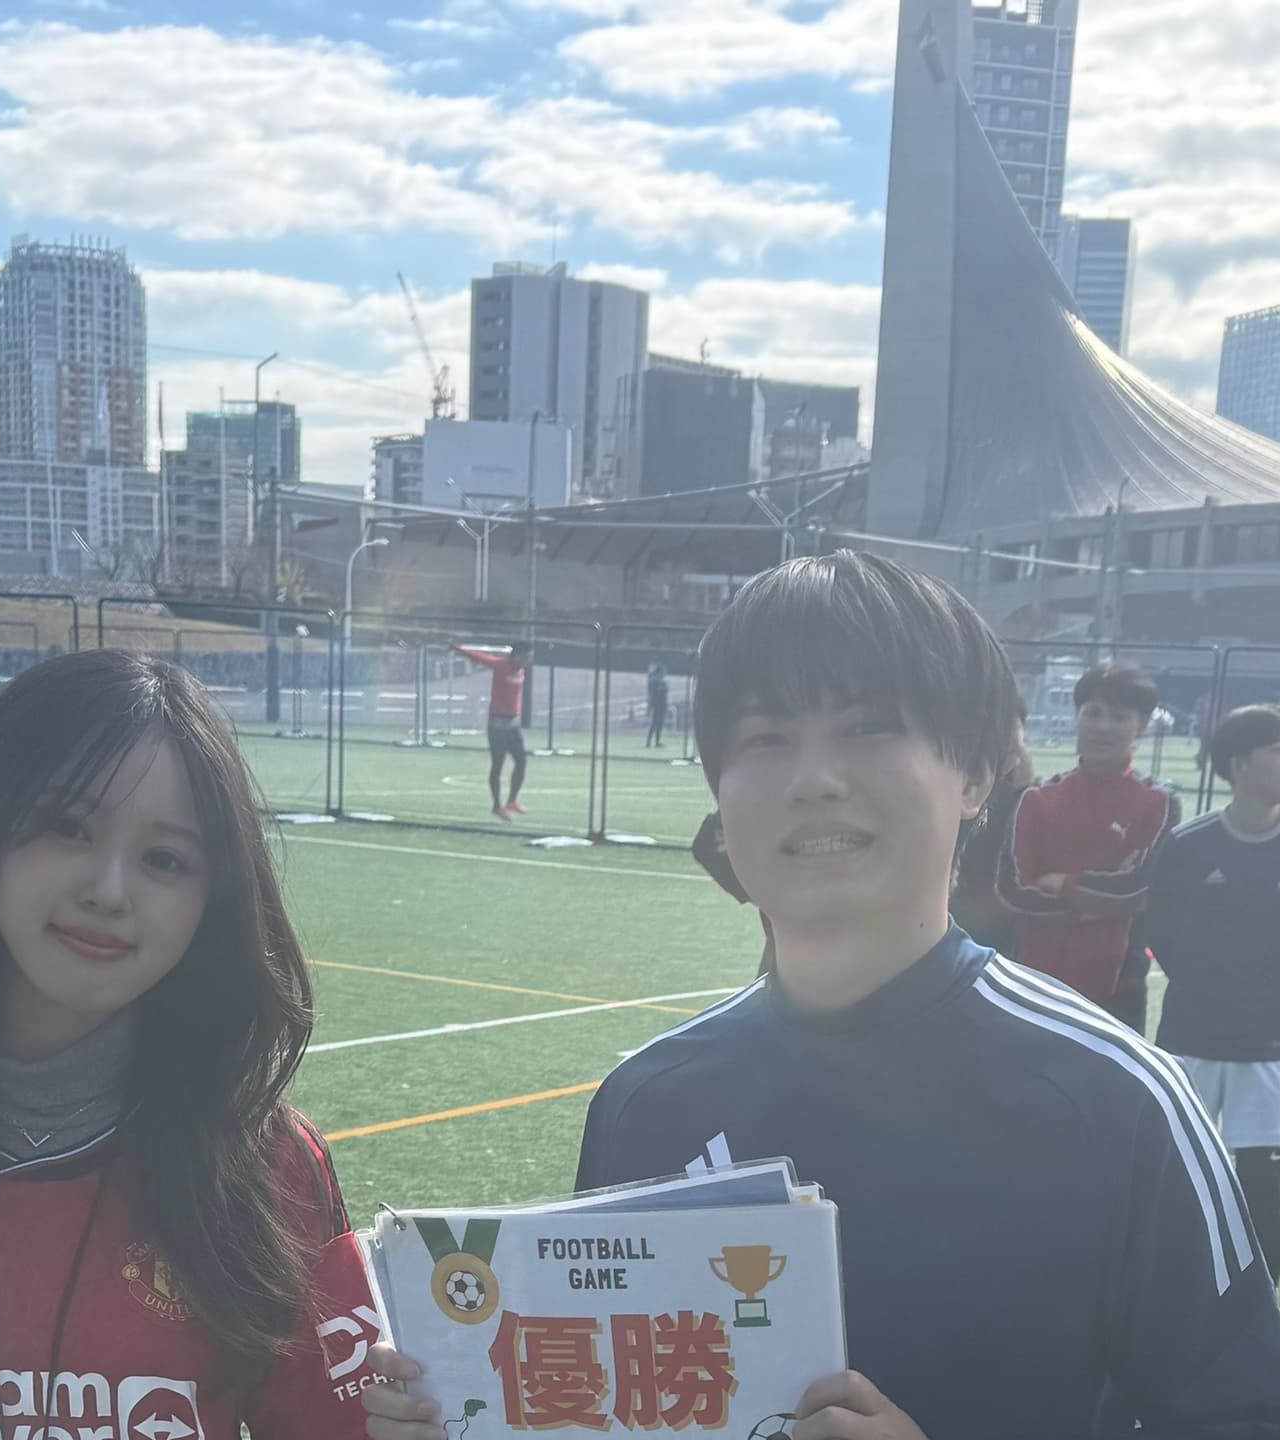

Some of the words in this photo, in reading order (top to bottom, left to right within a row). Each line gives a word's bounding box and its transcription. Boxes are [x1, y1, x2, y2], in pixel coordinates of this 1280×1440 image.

[537, 1238, 655, 1260] FOOTBALL
[568, 1267, 628, 1290] GAME
[488, 1310, 740, 1432] 優勝
